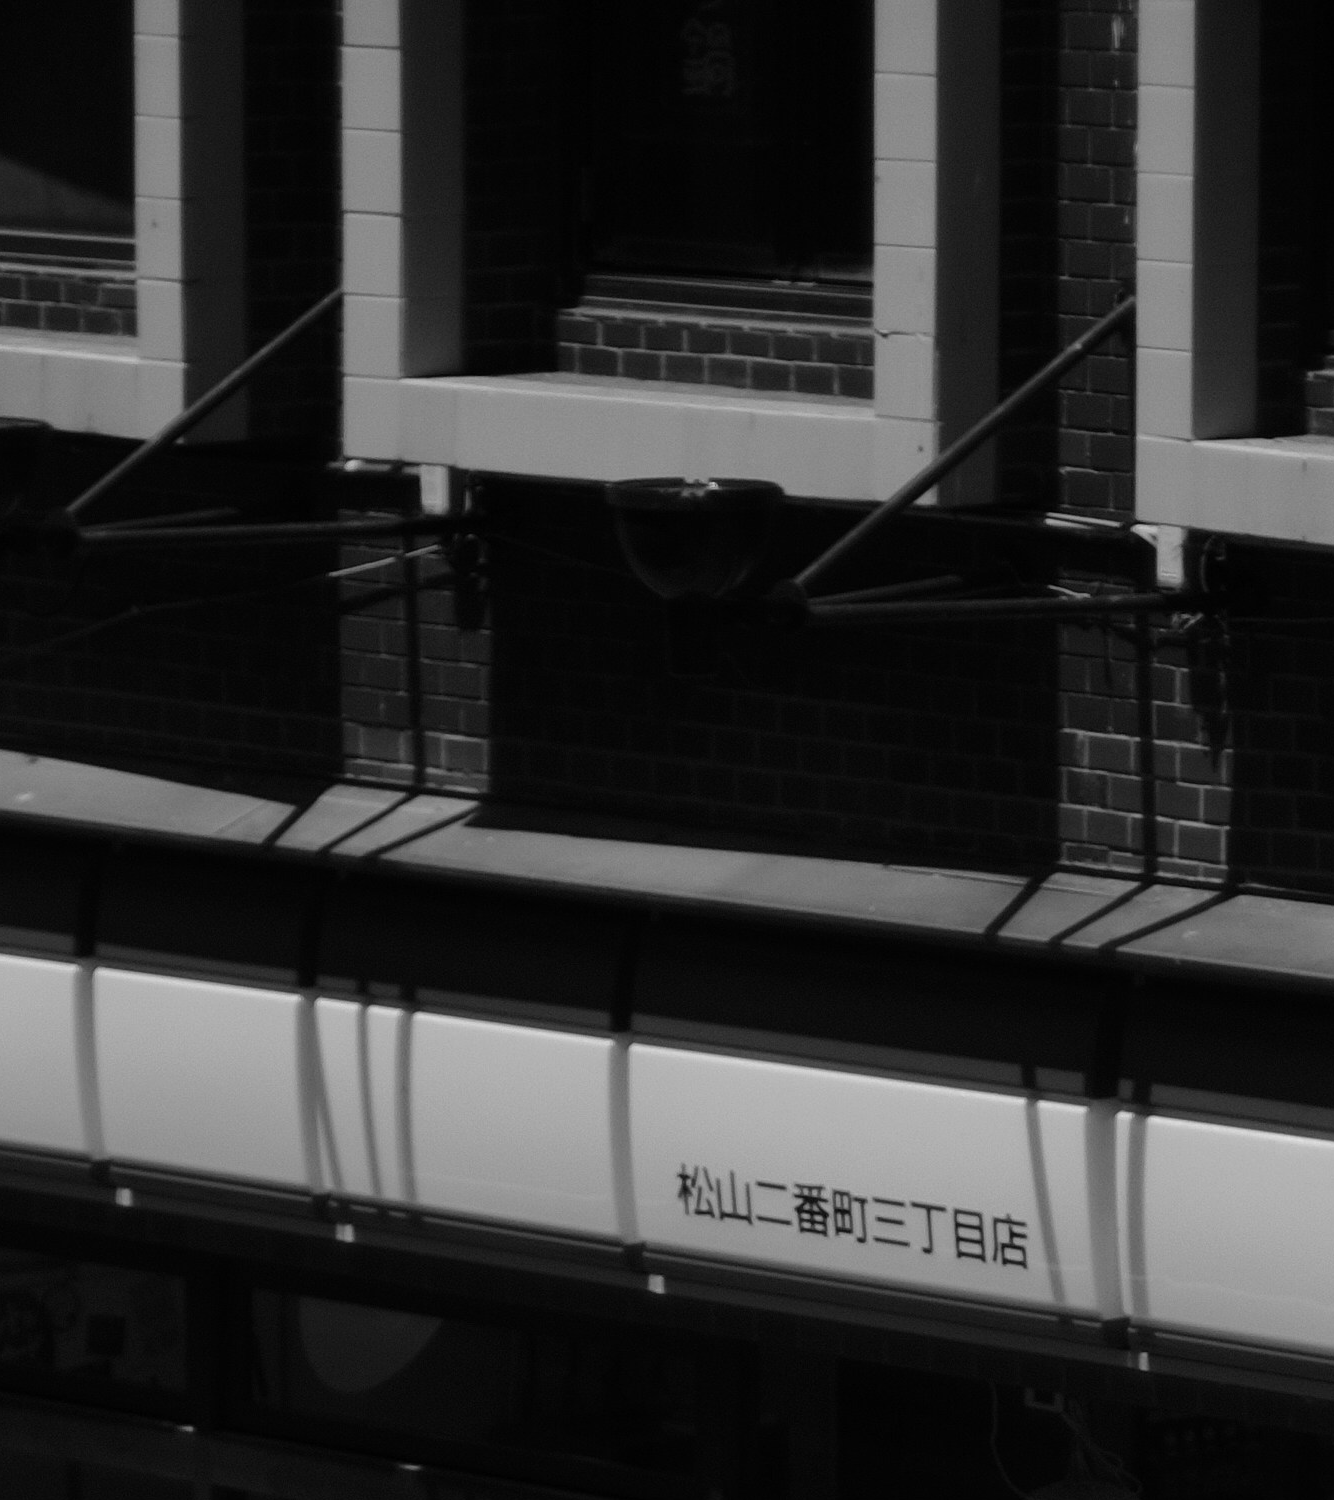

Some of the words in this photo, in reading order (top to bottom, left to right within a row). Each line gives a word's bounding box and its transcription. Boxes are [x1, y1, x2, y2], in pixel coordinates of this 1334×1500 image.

[676, 1162, 1029, 1270] 松山二番町三丁目店
